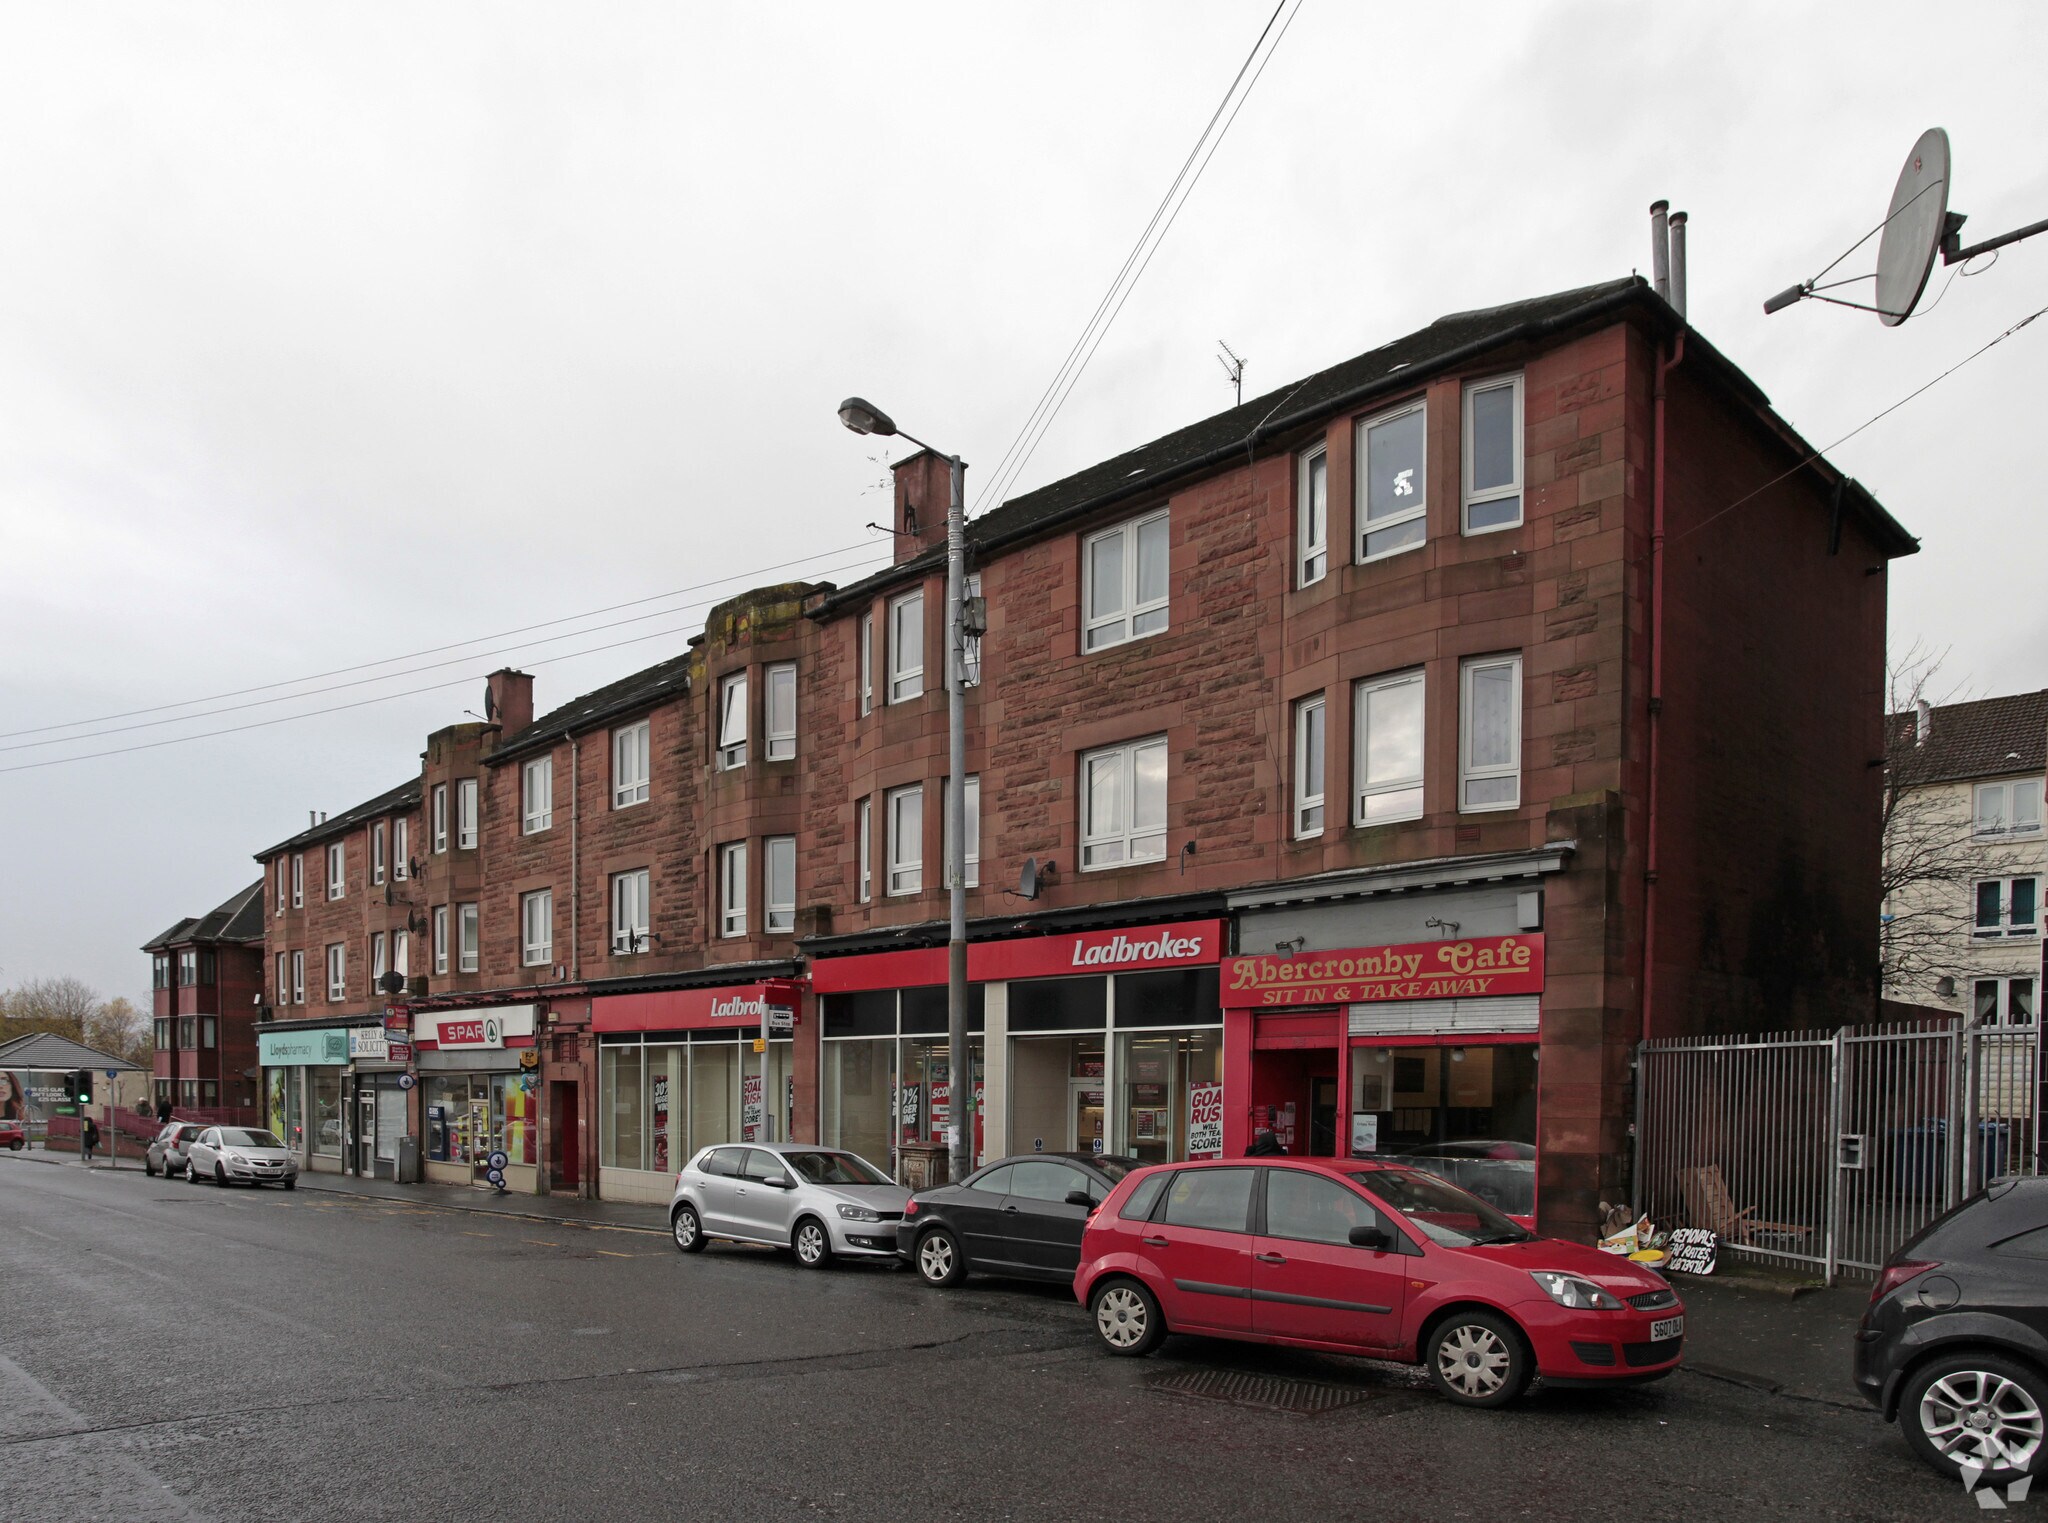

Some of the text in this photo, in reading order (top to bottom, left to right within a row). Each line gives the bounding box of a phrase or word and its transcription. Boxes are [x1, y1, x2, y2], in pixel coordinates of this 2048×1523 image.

[1072, 931, 1202, 966] Ladbrokes
[1229, 938, 1531, 990] Abercromby Cafe
[1262, 989, 1298, 1004] SIT
[1302, 987, 1327, 1002] IN
[1333, 986, 1351, 1000] &
[361, 1030, 378, 1040] KELLY
[447, 1024, 485, 1041] SPAR
[270, 1043, 312, 1058] Lloydspharmacy
[1191, 1107, 1222, 1125] RUS
[1191, 1131, 1207, 1139] BOTH
[1203, 1123, 1218, 1131] WILL
